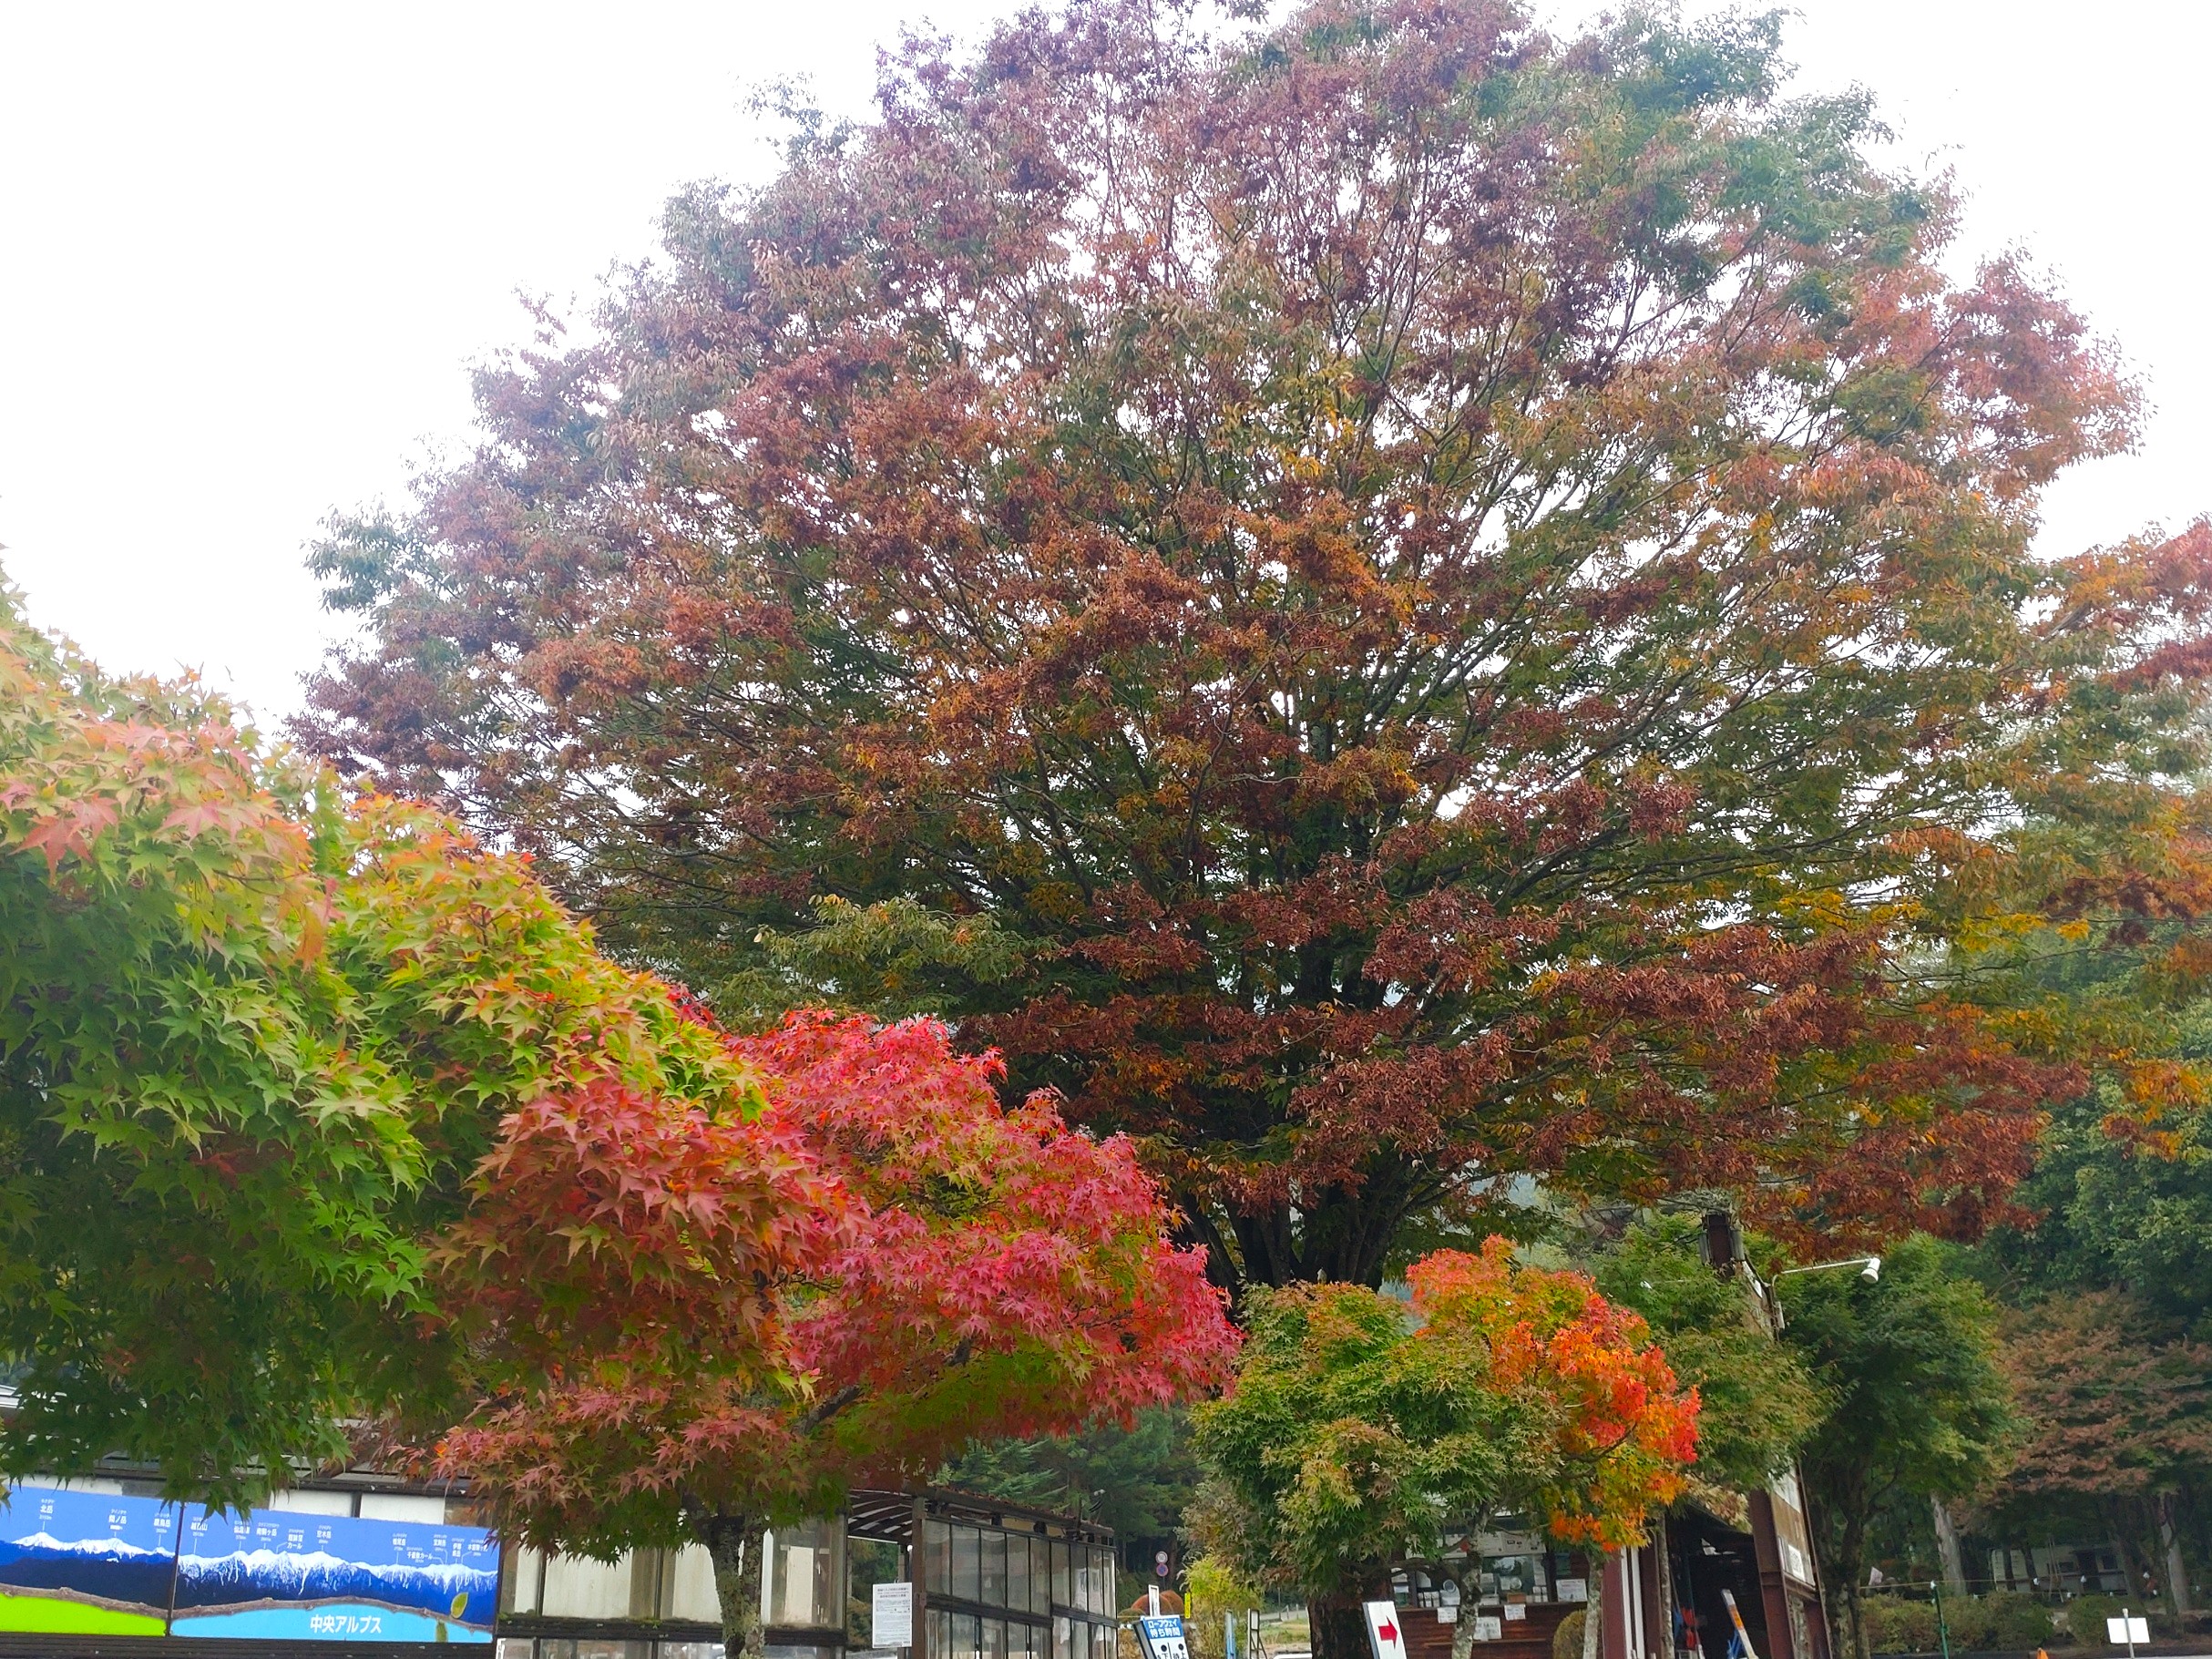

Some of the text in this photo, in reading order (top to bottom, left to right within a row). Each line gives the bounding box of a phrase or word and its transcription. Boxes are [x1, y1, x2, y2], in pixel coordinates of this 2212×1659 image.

[40, 1504, 54, 1514] 北岳
[310, 1613, 382, 1633] 中央アルプス
[1148, 1619, 1178, 1629] ロープウェイ
[1150, 1626, 1182, 1638] 待ち時間
